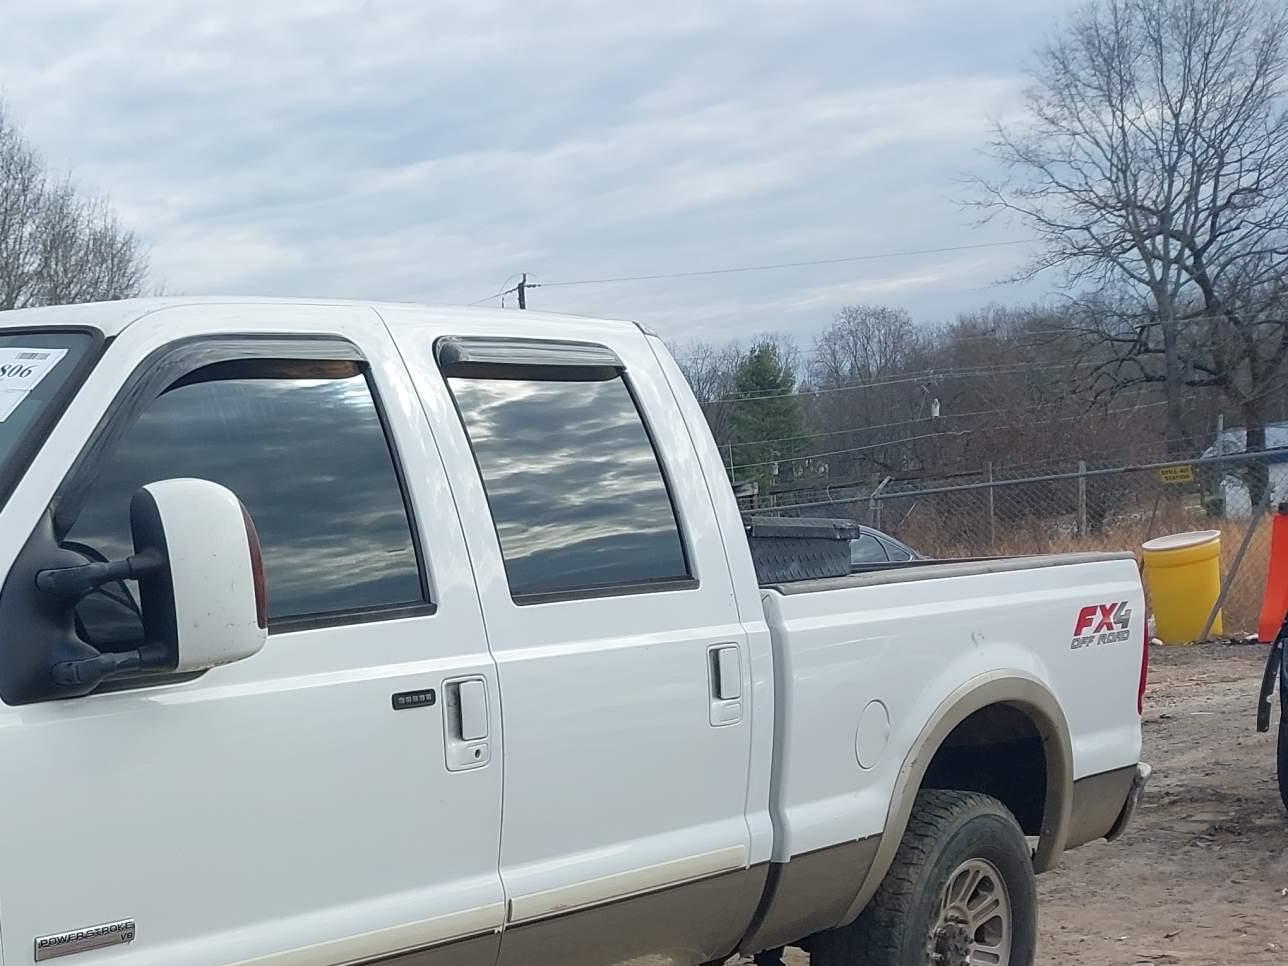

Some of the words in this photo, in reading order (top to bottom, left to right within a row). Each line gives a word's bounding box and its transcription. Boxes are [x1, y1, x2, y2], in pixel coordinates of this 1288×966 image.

[1074, 600, 1132, 636] FX4
[1071, 635, 1095, 649] OFF
[1097, 630, 1130, 646] ROAD
